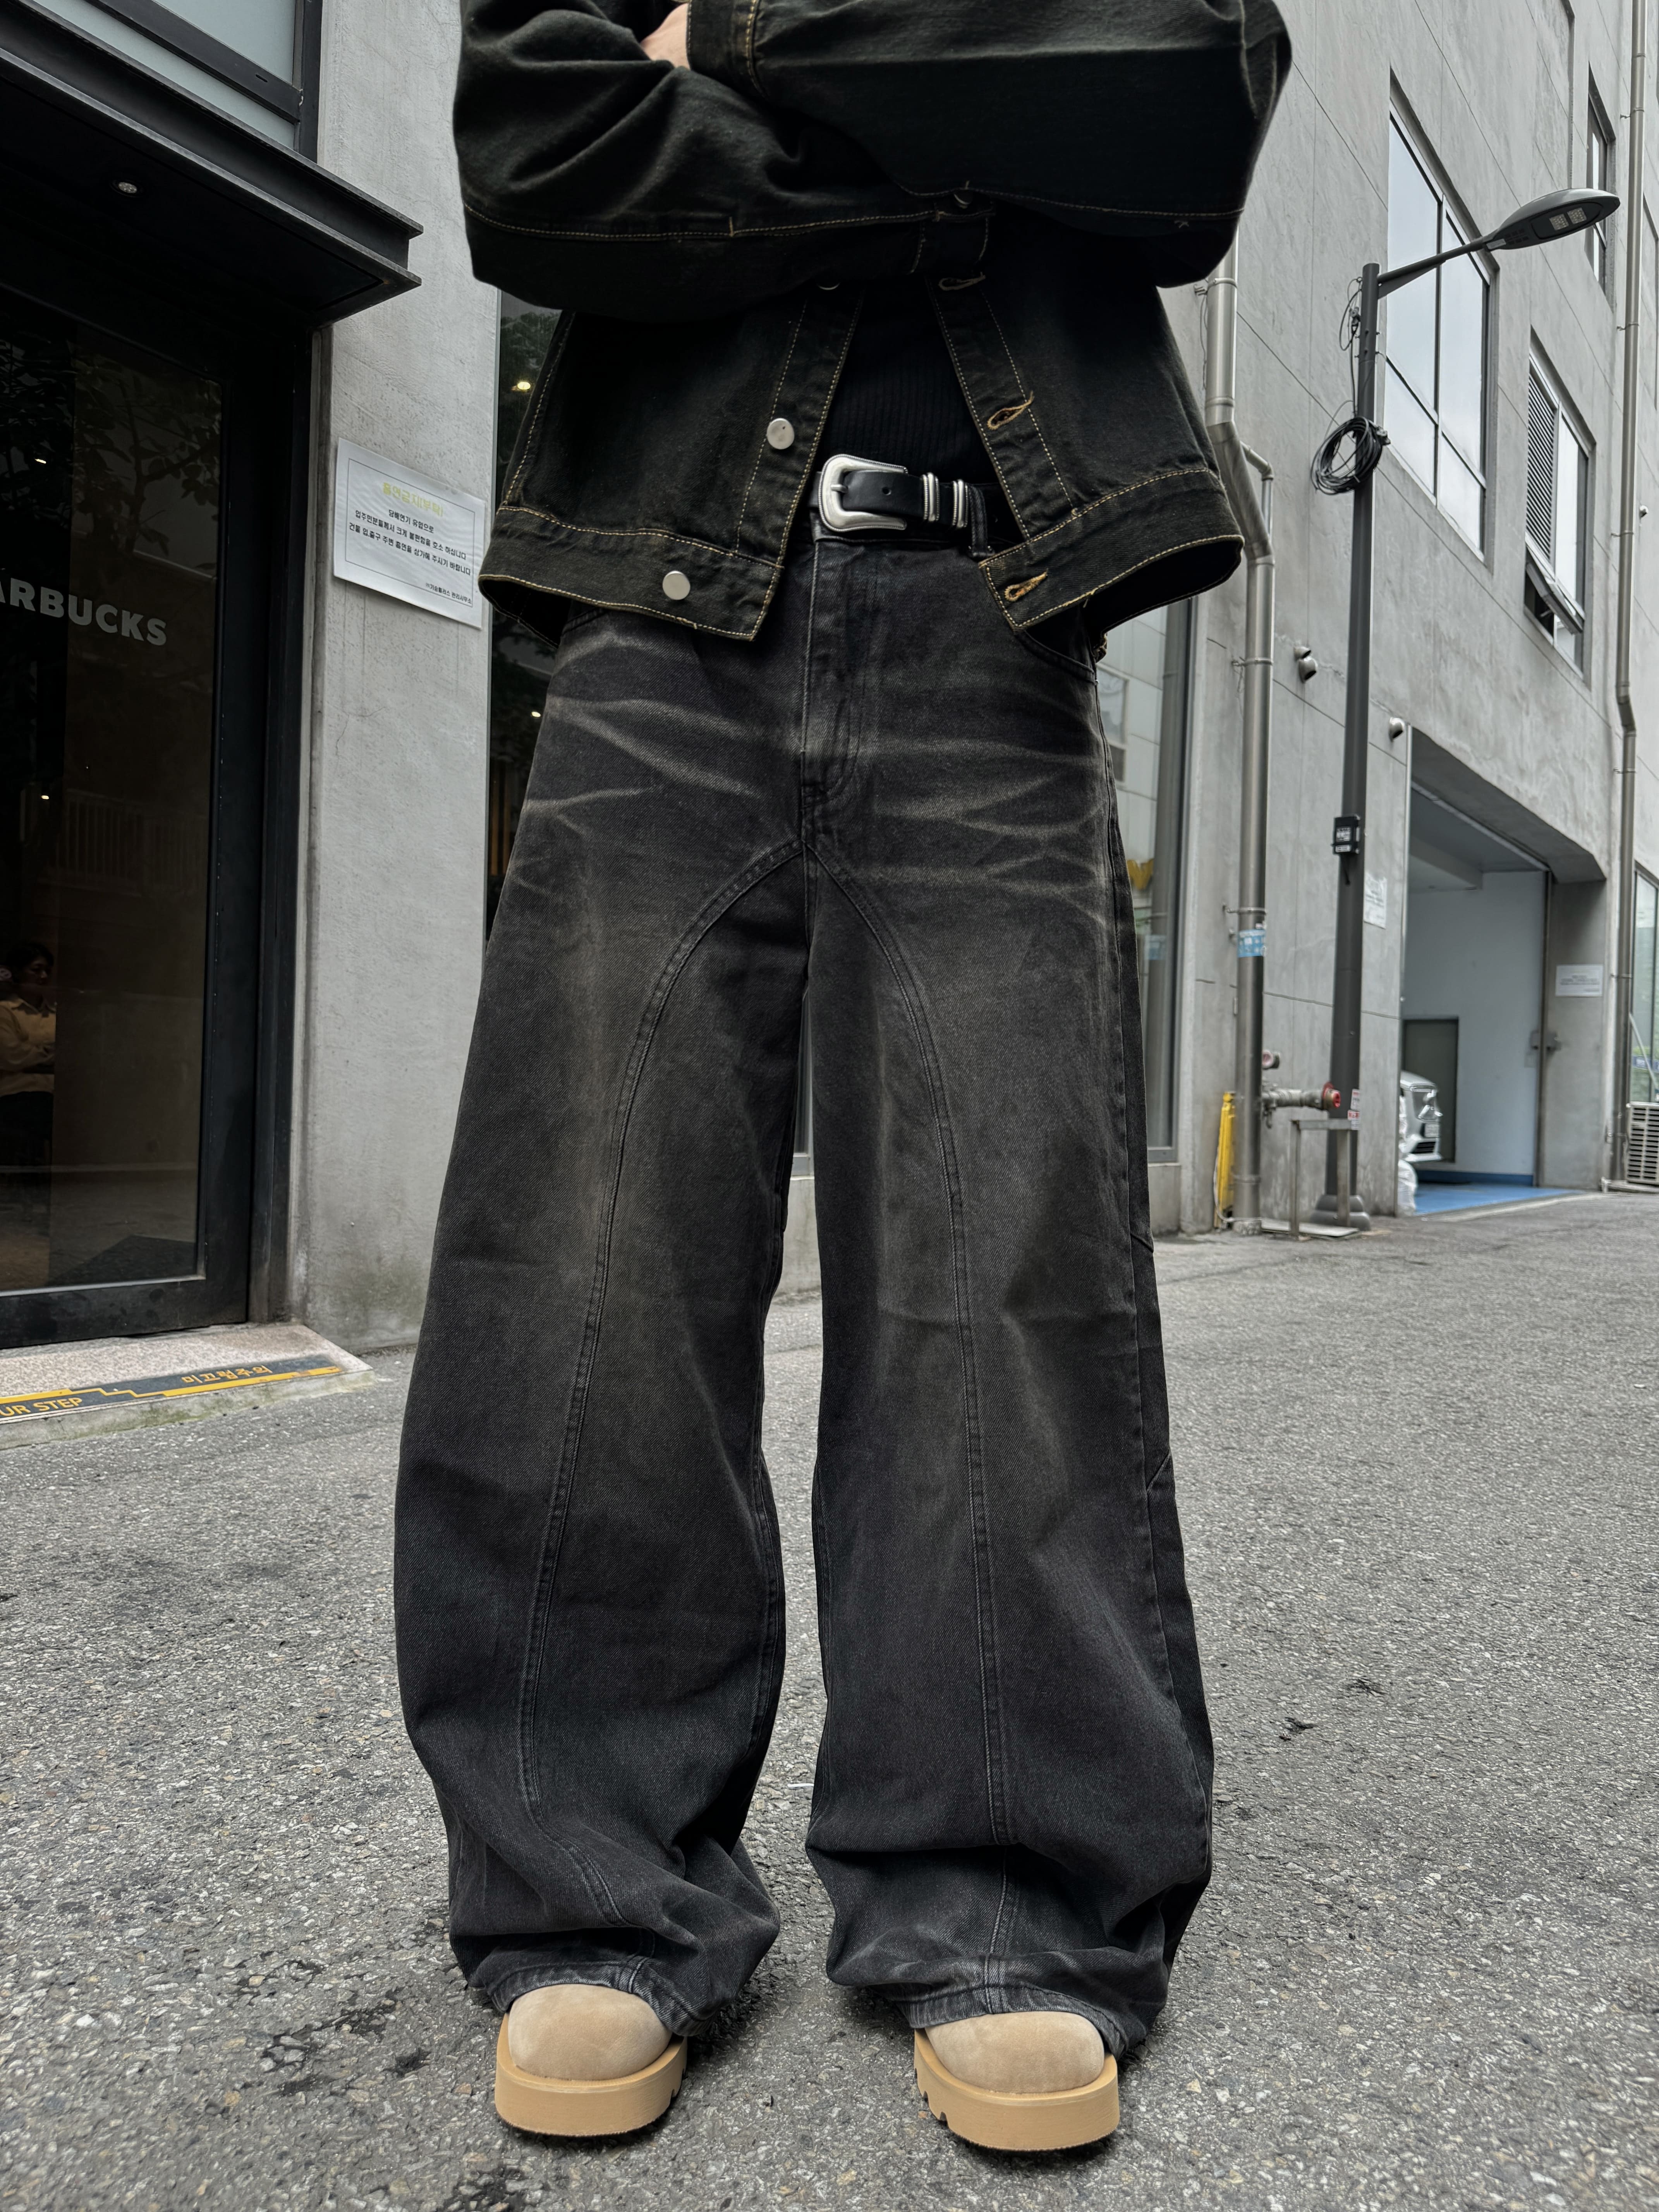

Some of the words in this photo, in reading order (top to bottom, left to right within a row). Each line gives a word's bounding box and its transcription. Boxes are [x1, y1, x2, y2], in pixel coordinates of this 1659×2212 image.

[356, 510, 395, 532] 입주민분들께서
[396, 527, 407, 538] 크게
[409, 532, 431, 546] 불편함을
[433, 541, 443, 551] 호소
[445, 546, 466, 560] 하십니다
[389, 509, 410, 524] 담배연기
[412, 518, 434, 533] 유입으로
[349, 522, 361, 533] 건물
[383, 536, 394, 546] 주변
[396, 541, 412, 553] 흡연을
[432, 555, 448, 567] 주시기
[450, 562, 471, 575] 바랍니다
[0, 577, 167, 646] RBUCKS
[181, 1365, 273, 1383] 미끄럼주의
[33, 1397, 82, 1411] STEP
